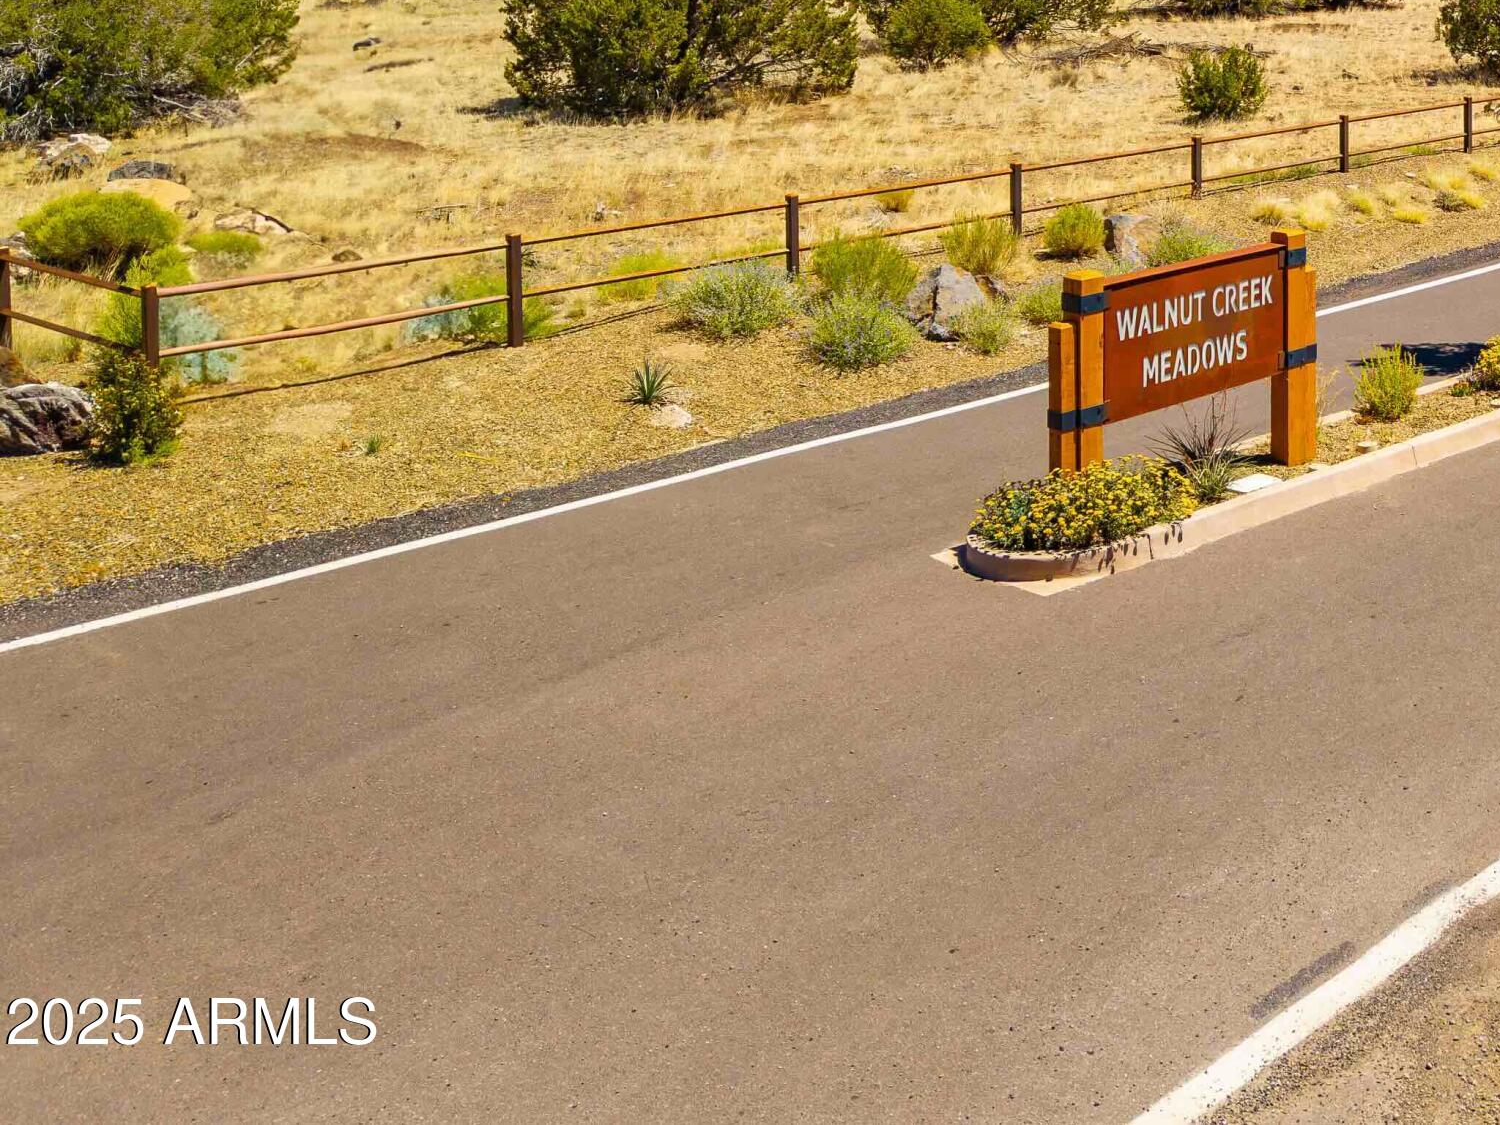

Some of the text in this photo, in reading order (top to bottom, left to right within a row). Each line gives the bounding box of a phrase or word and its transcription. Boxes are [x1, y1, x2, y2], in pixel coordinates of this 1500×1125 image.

[1117, 275, 1273, 342] WALNUT CREEK
[1142, 330, 1248, 388] MEADOWS
